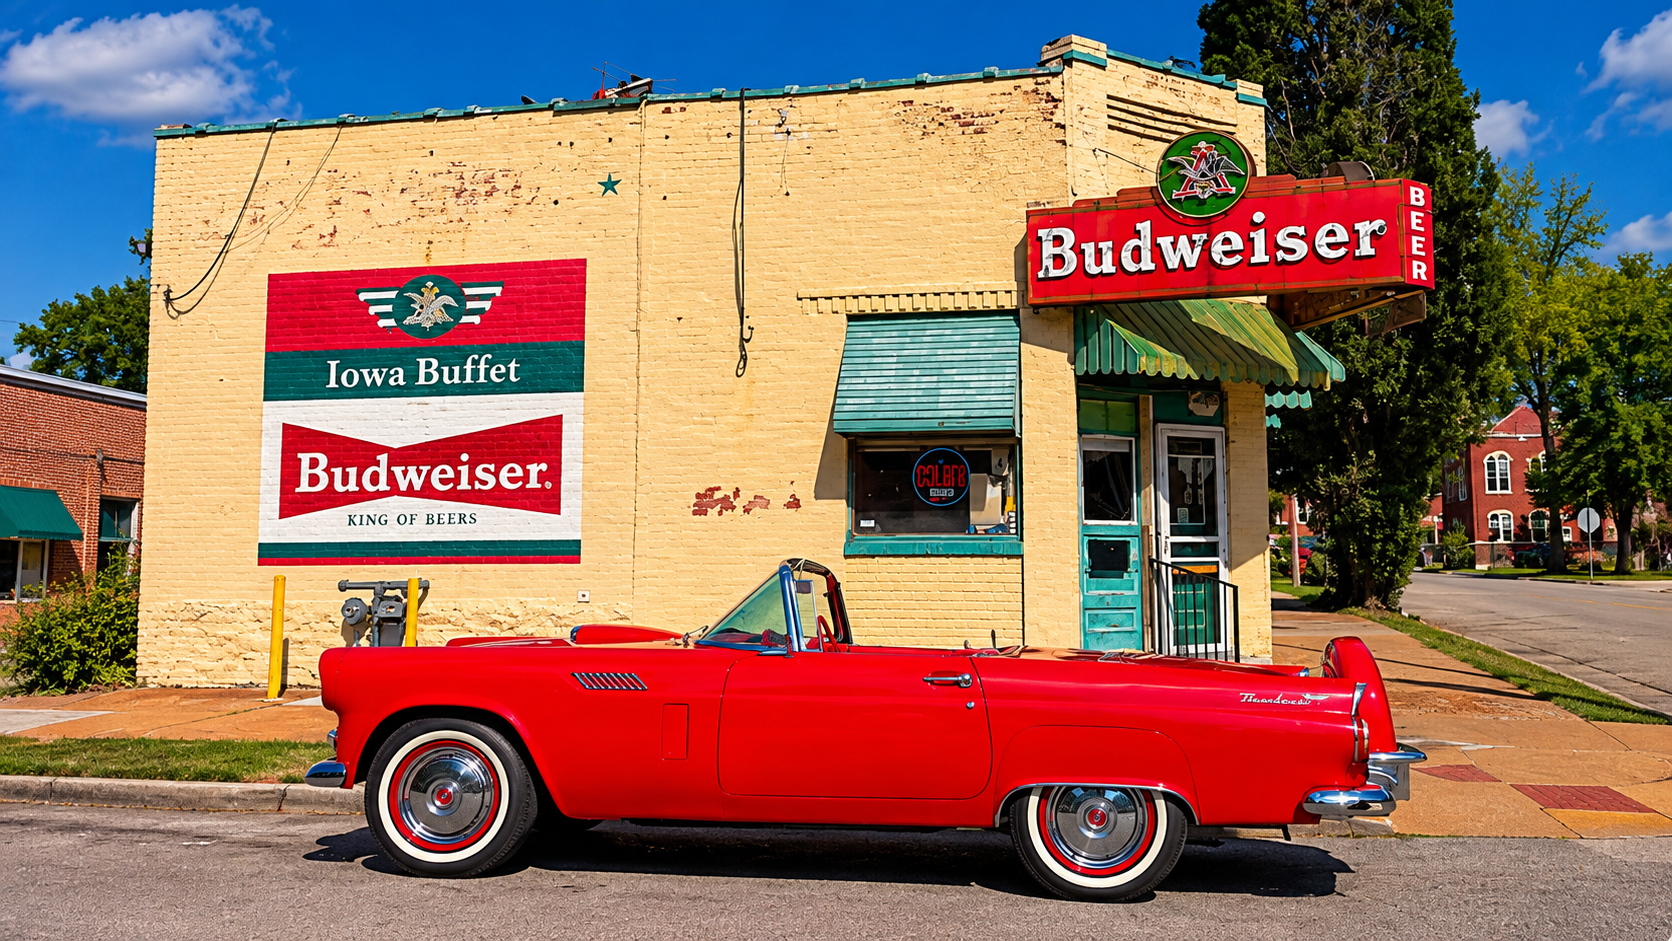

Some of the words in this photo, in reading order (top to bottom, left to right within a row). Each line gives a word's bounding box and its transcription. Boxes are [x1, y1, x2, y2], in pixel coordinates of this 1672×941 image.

[1037, 211, 1388, 279] Budweiser
[1409, 185, 1428, 281] BEER
[325, 360, 407, 388] Iowa
[414, 354, 521, 386] Buffet
[294, 452, 548, 493] Budweiser
[347, 513, 388, 527] KING
[396, 513, 417, 526] OF
[425, 512, 478, 526] BEERS
